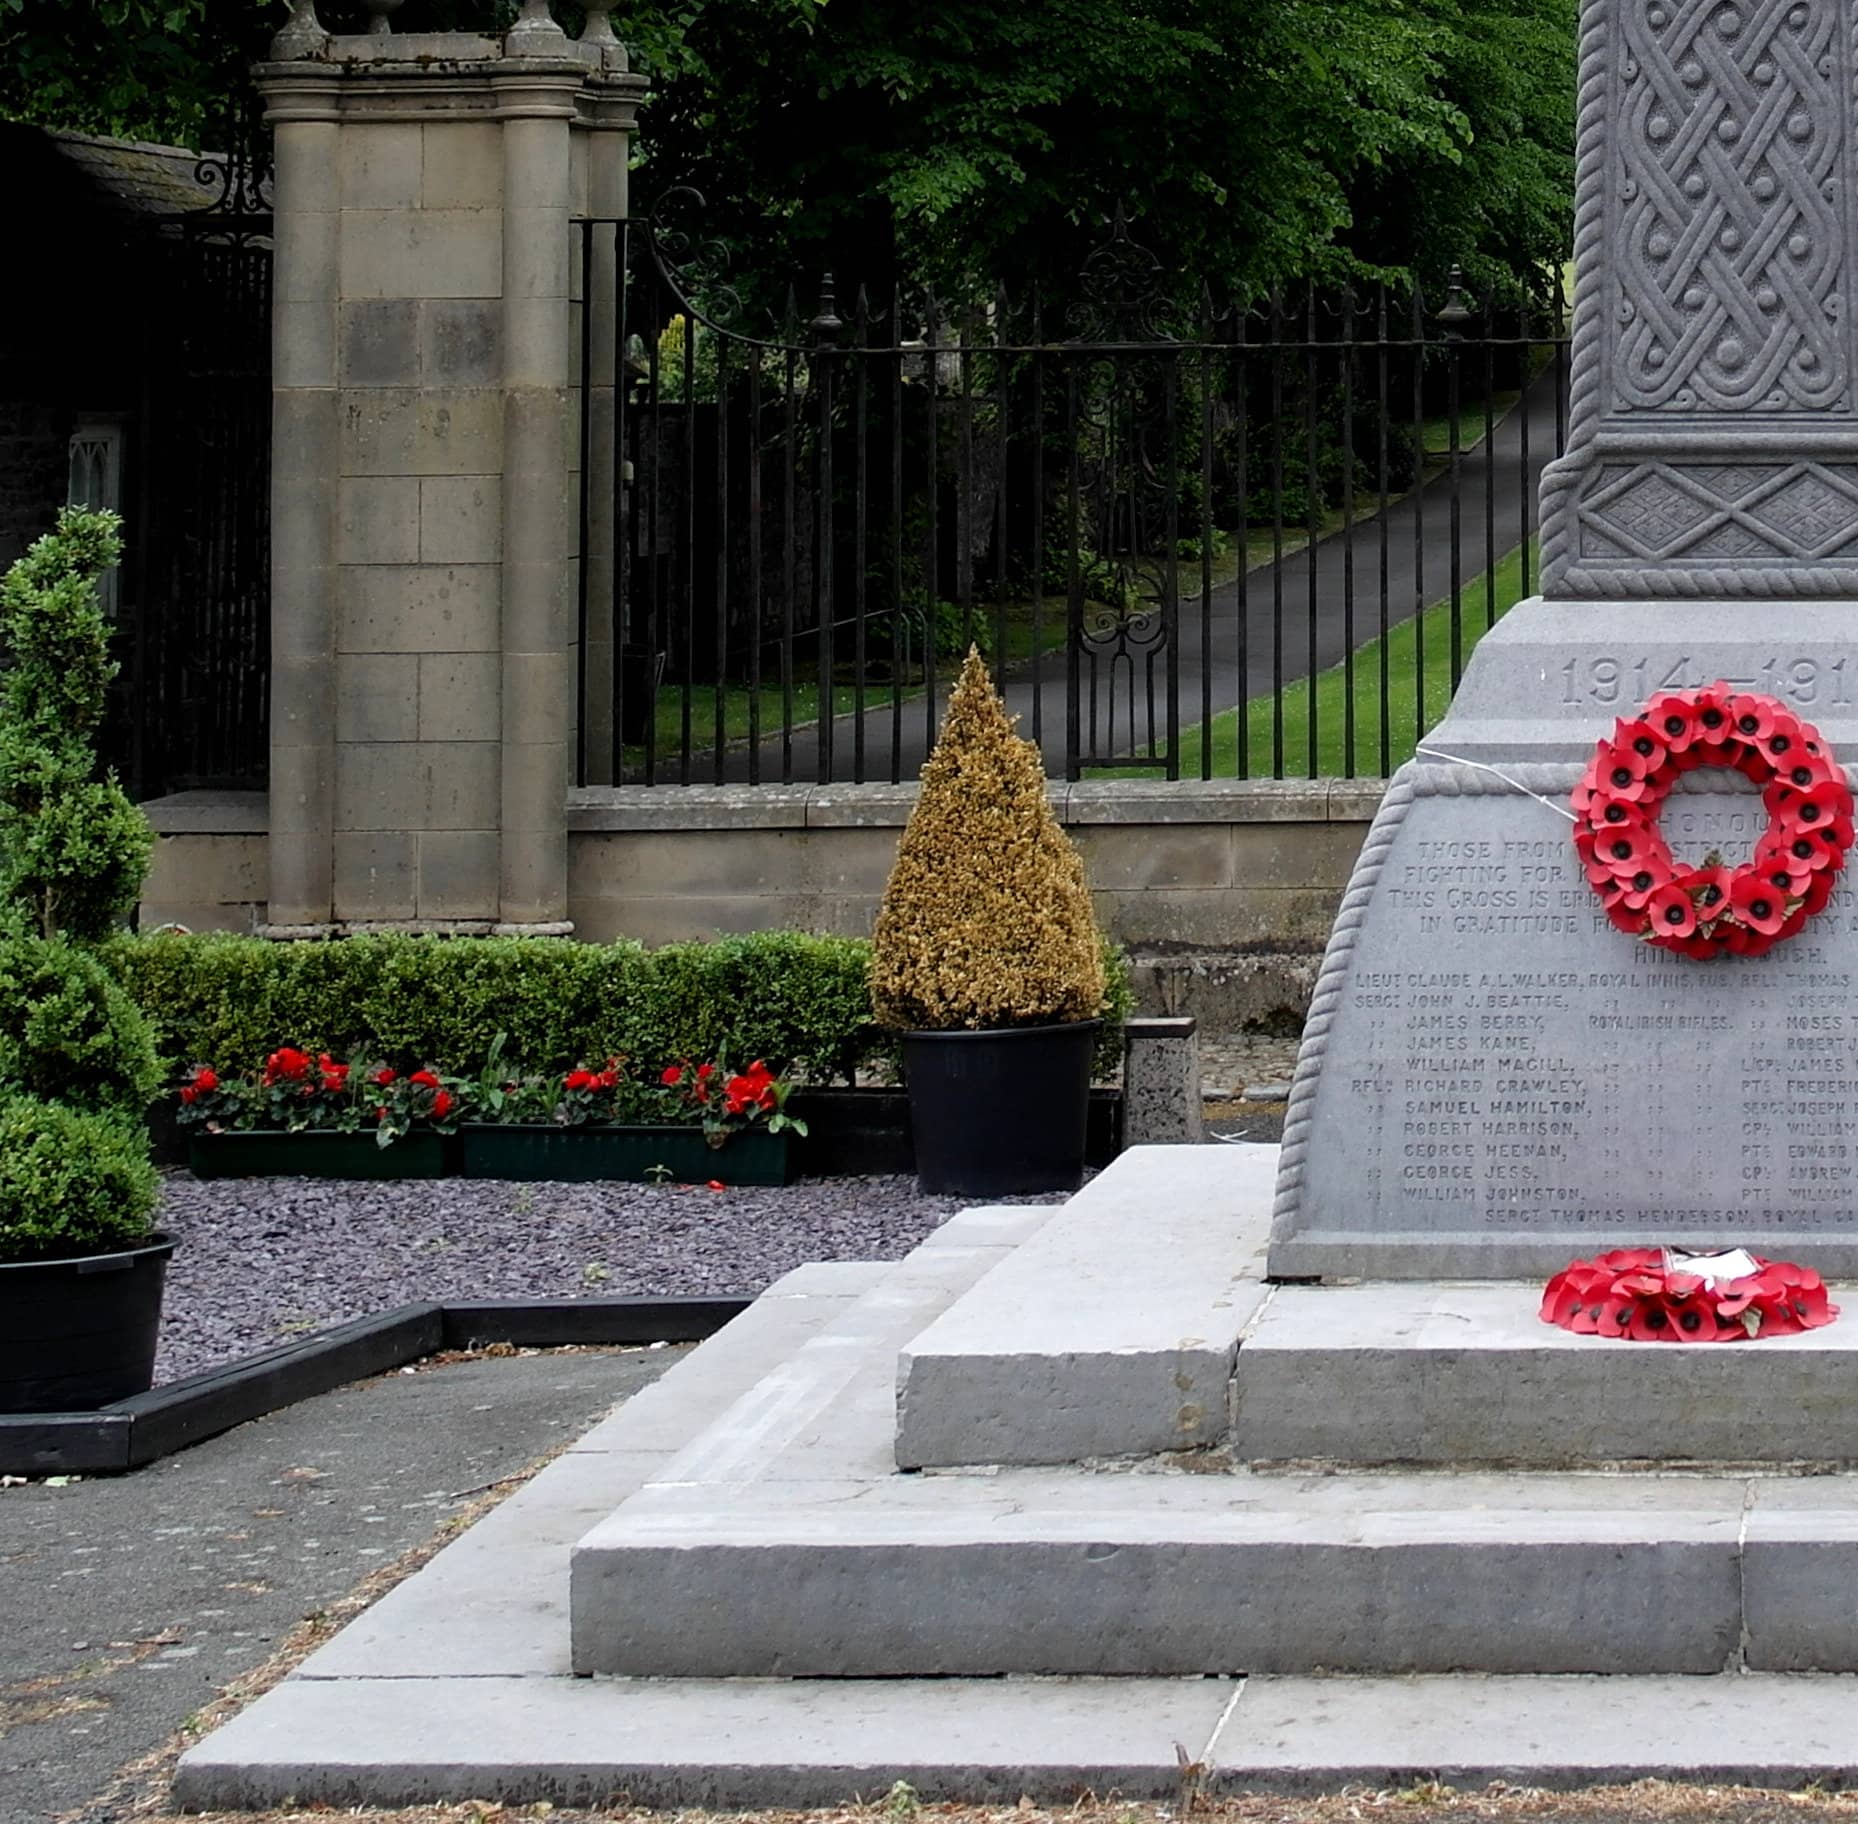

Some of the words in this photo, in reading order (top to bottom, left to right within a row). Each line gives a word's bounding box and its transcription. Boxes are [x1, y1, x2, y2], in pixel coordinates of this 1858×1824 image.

[1418, 841, 1491, 860] THOSE
[1503, 841, 1566, 860] FROM
[1404, 865, 1508, 884] FIGHTING
[1519, 865, 1568, 883] FOR
[1387, 888, 1435, 908] THIS
[1446, 887, 1518, 908] CROSS
[1528, 888, 1550, 907] IS
[1419, 915, 1440, 934] IN
[1453, 915, 1579, 935] GRATITUDE
[1407, 973, 1472, 988] CLAUDE
[1588, 973, 1640, 988] ROYAL
[1407, 994, 1453, 1009] JOHN
[1464, 994, 1481, 1008] J.
[1786, 994, 1848, 1009] JOSEPH
[1406, 1015, 1468, 1030] JAMES
[1588, 1015, 1635, 1030] ROYAL
[1636, 1015, 1674, 1030] IRISH
[1678, 1015, 1735, 1030] RIFLES.
[1786, 1015, 1843, 1030] MOSES
[1406, 1036, 1468, 1051] JAMES
[1479, 1036, 1536, 1054] KANE,
[1786, 1037, 1845, 1052] ROBERT
[1406, 1058, 1485, 1072] WILLIAM
[1786, 1058, 1846, 1073] JAMES
[1404, 1079, 1483, 1093] RICHARD
[1405, 1100, 1481, 1114] SAMUEL
[1489, 1100, 1594, 1118] HAMILTON,
[1786, 1101, 1845, 1115] JOSEPH
[1403, 1121, 1472, 1136] ROBERT
[1786, 1122, 1857, 1137] WILLIAM
[1403, 1144, 1475, 1158] GEORGE
[1787, 1144, 1847, 1159] EDWARD
[1403, 1165, 1474, 1180] GEORGE
[1484, 1165, 1539, 1183] JESS,
[1403, 1187, 1476, 1201] WILLIAM
[1787, 1188, 1853, 1202] WILLIAM
[1550, 1209, 1626, 1224] THOMAS
[1761, 1209, 1823, 1224] ROYAL
